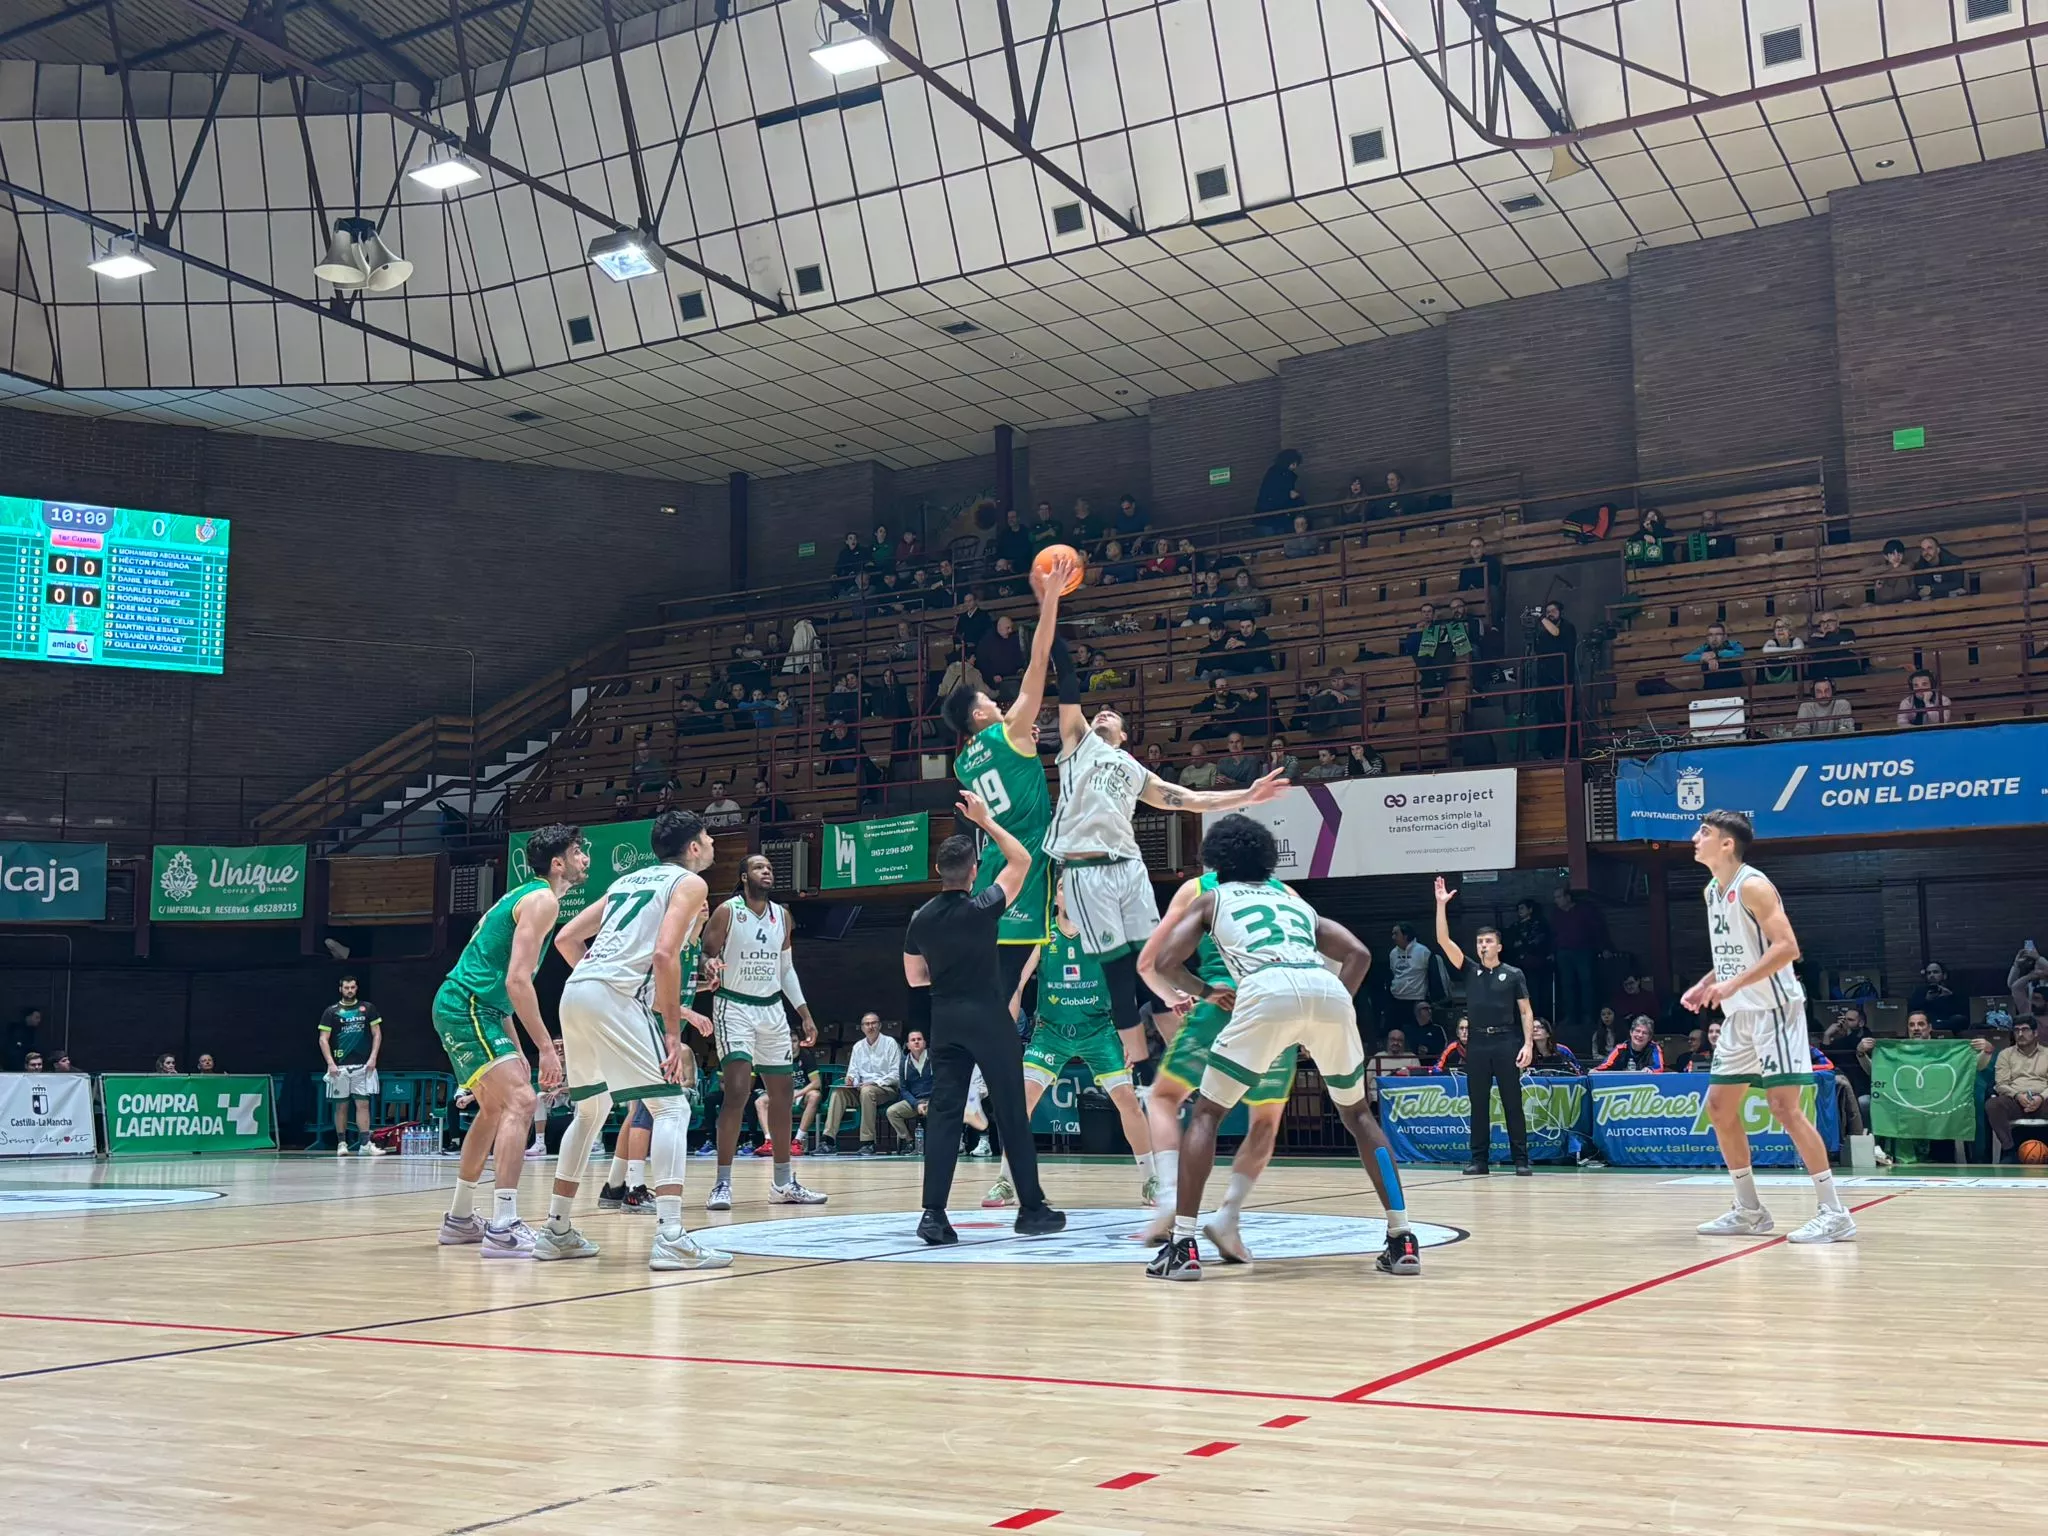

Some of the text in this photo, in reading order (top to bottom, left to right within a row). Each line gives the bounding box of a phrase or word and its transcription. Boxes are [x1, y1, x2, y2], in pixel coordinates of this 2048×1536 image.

[51, 507, 107, 526] 10:00
[152, 518, 165, 537] 0
[119, 549, 158, 558] MOHAMMED
[56, 558, 95, 575] 0 0
[118, 566, 144, 574] PABLO
[151, 560, 190, 570] FIGUEROA
[144, 578, 174, 587] SHELIST
[54, 588, 93, 605] 0 0
[117, 585, 152, 594] CHARLES
[153, 588, 190, 597] KNOWLES
[116, 594, 153, 604] RODRIGO
[115, 613, 135, 621] ALEX
[145, 625, 179, 634] IGLESIAS
[52, 640, 76, 649] amlab
[114, 631, 154, 641] LYSANDER
[156, 635, 187, 644] BRACEY
[1819, 759, 1915, 782] JUNTOS
[972, 767, 1012, 819] 19
[1412, 788, 1494, 806] areaproject
[1821, 776, 2021, 807] CON EL DEPORTE
[1395, 810, 1483, 823] Hacemos simple la
[1631, 810, 1695, 821] AYUNTAMIENTO
[1388, 819, 1492, 834] transformación digital
[1405, 845, 1476, 856] www.areaproject.com
[208, 857, 300, 894] Unique
[215, 905, 250, 914] RESERVAS
[253, 902, 298, 913] 685289215
[600, 889, 657, 932] 77
[1231, 904, 1318, 953] 33
[1713, 914, 1730, 935] 24
[755, 928, 767, 944] 4
[1067, 946, 1076, 960] 8
[1714, 941, 1744, 955] obe
[1060, 995, 1099, 1006] Globalcaja
[784, 1049, 792, 1063] 4
[117, 1093, 199, 1114] COMPRA
[1380, 1084, 1472, 1123] Tallere
[1591, 1083, 1700, 1126] Talleres
[1396, 1125, 1471, 1135] AUTOCENTROS
[1606, 1127, 1687, 1138] AUTOCENTROS
